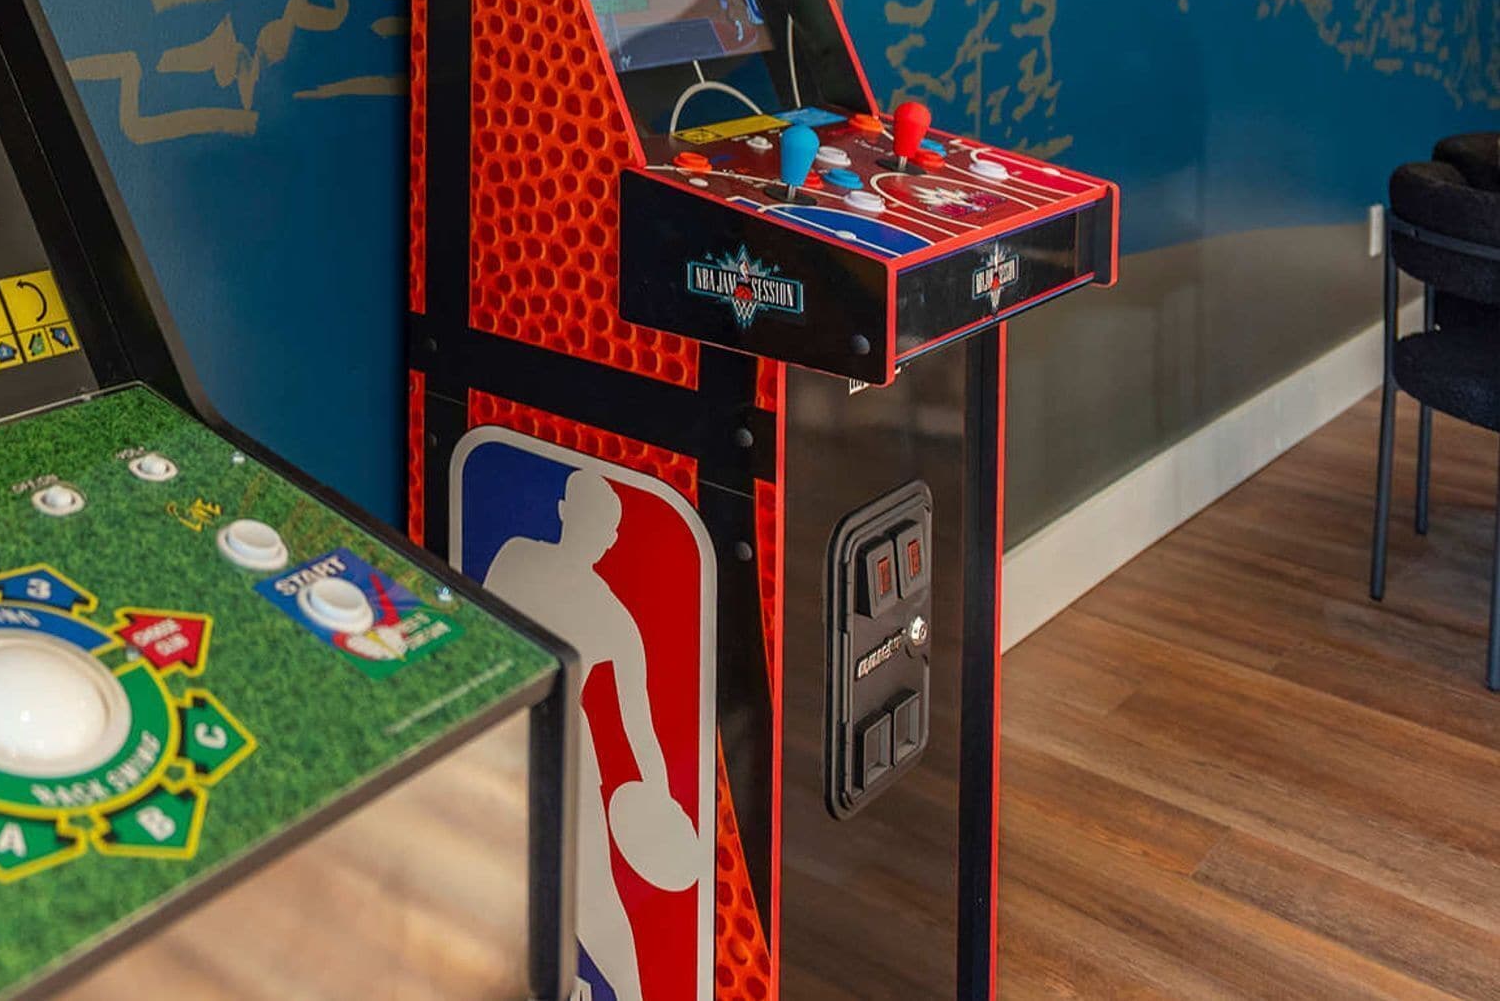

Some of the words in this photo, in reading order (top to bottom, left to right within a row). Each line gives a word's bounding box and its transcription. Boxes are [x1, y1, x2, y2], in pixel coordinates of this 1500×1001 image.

[696, 266, 716, 292] NBA
[716, 270, 738, 296] JAM
[751, 277, 794, 308] SESSION
[26, 578, 52, 600] 3
[274, 555, 348, 596] START
[194, 721, 227, 750] C
[136, 806, 176, 841] B
